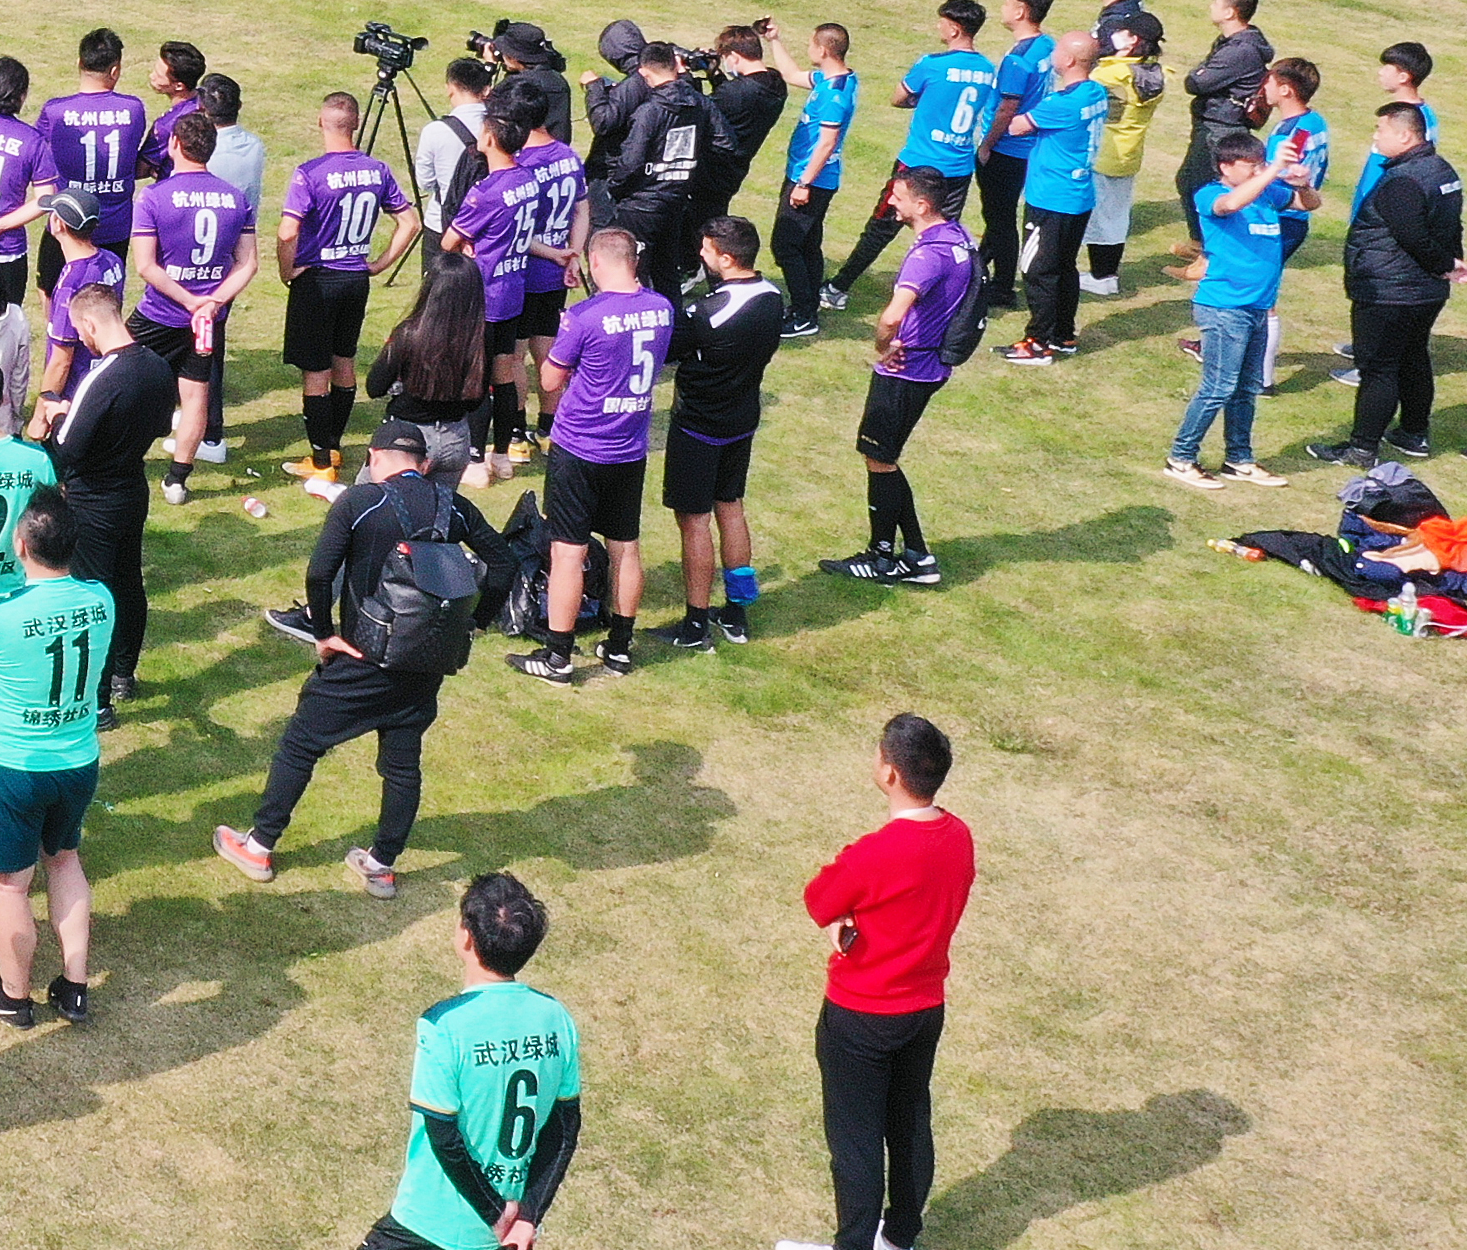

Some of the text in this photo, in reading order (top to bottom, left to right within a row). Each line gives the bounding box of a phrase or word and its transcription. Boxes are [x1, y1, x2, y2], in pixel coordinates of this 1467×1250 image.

[64, 109, 131, 127] 杭州绿城
[950, 86, 978, 134] 6
[80, 129, 120, 181] 11
[171, 191, 236, 209] 杭州绿城
[335, 191, 376, 245] 10
[545, 176, 577, 233] 12
[191, 208, 218, 265] 9
[506, 200, 538, 256] 15
[166, 264, 224, 281] 国际社区
[602, 309, 670, 335] 杭州绿城
[629, 329, 656, 395] 5
[22, 603, 107, 639] 武汉绿城
[45, 629, 90, 707] 11
[22, 702, 91, 727] 锦绣社区
[473, 1032, 560, 1067] 武汉绿城
[497, 1068, 538, 1160] 6
